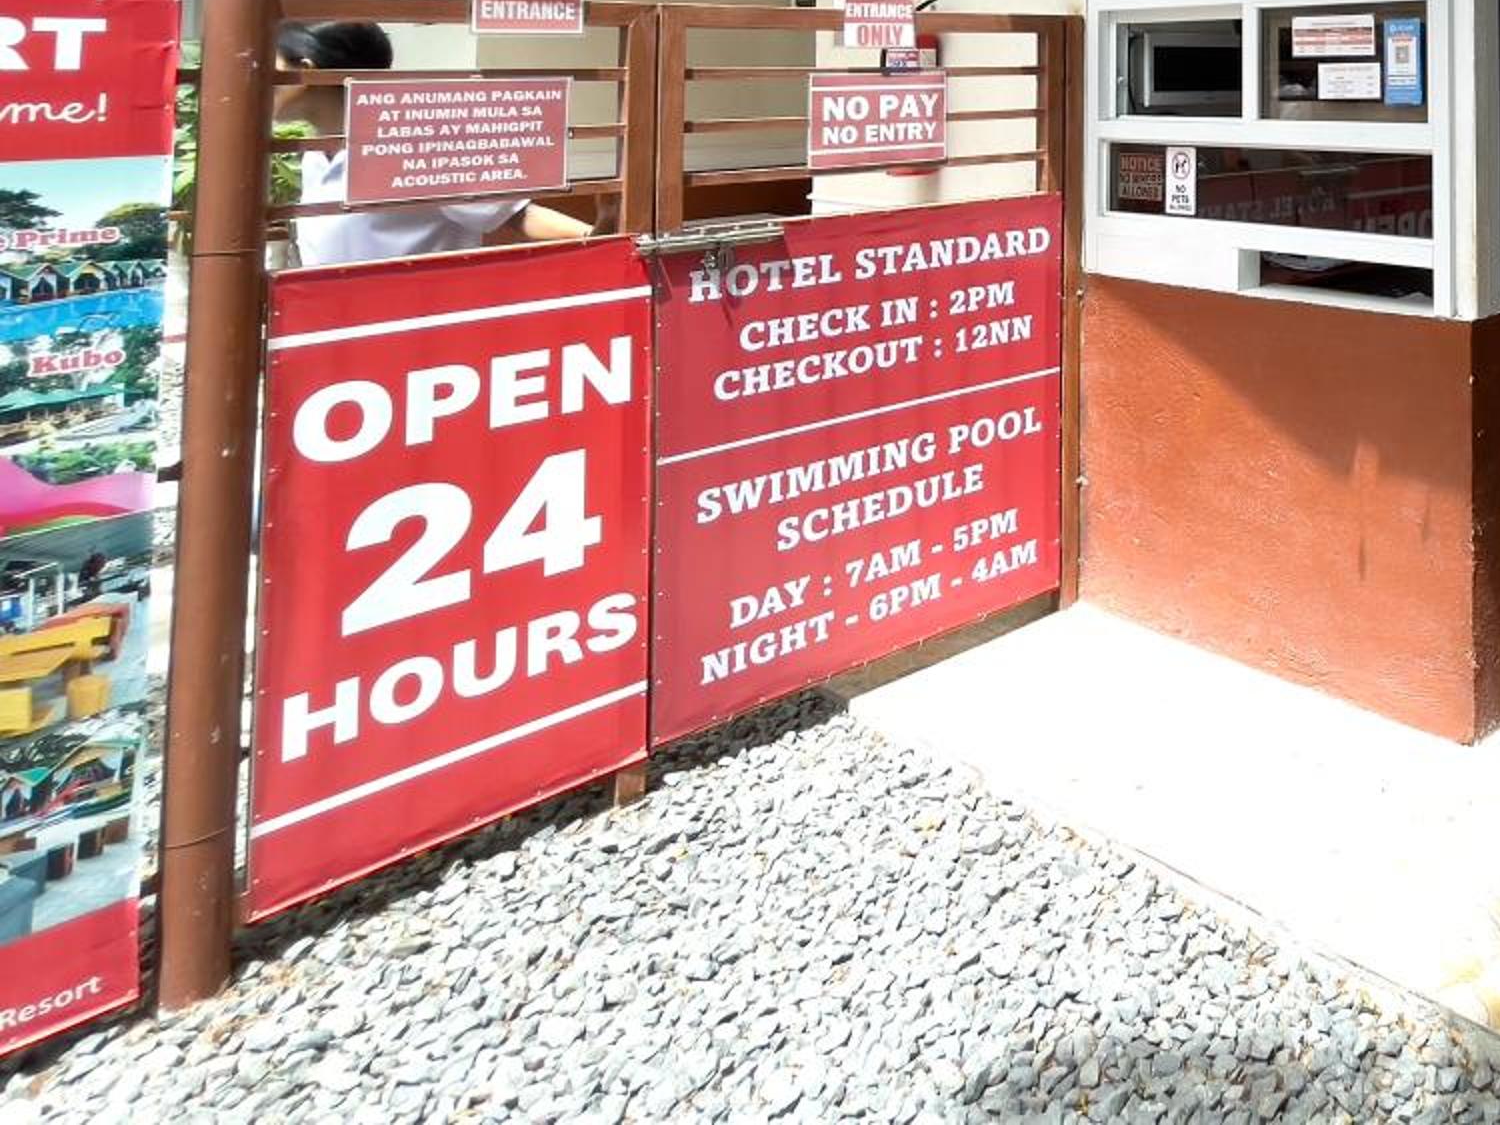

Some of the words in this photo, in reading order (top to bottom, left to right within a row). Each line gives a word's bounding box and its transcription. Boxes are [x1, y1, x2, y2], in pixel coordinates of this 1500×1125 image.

[481, 0, 576, 21] ENTRANCE
[846, 2, 913, 19] ENTRANCE
[857, 25, 903, 46] ONLY
[356, 92, 396, 106] ANG
[401, 90, 487, 104] ANUMANG
[491, 90, 562, 103] PAGKAIN
[823, 95, 870, 122] NO
[879, 93, 938, 120] PAY
[378, 110, 401, 122] AT
[406, 108, 470, 121] INUMIN
[472, 106, 517, 118] MULA
[520, 105, 543, 116] SA
[377, 126, 434, 138] LABAS
[439, 125, 462, 136] AY
[465, 120, 544, 135] MAHIGPIT
[822, 125, 858, 146] NO
[865, 121, 937, 144] ENTRY
[361, 143, 413, 156] PONG
[419, 136, 555, 153] IPINAGBABAWAL
[402, 158, 427, 171] NA
[432, 155, 495, 169] IPASOK
[498, 153, 519, 164] SA
[392, 172, 477, 188] ACOUSTIC
[480, 168, 528, 182] AREA.
[1176, 184, 1186, 193] NO
[15, 227, 119, 249] Prime
[688, 254, 841, 304] HOTEL
[855, 226, 1051, 281] STANDARD
[740, 304, 870, 352] CHECK
[880, 296, 919, 327] IN
[929, 298, 938, 318] :
[949, 281, 1016, 315] 2PM
[32, 349, 125, 374] Kubo
[713, 336, 924, 401] CHECKOUT
[933, 338, 943, 358] :
[954, 315, 1034, 353] 12NN
[292, 334, 633, 463] OPEN
[696, 432, 936, 525] SWIMMING
[949, 407, 1042, 455] POOL
[777, 463, 985, 552] SCHEDULE
[341, 448, 602, 637] 24
[729, 574, 812, 630] DAY
[823, 574, 833, 596] :
[845, 538, 922, 588] 7AM
[952, 508, 1019, 552] 5PM
[700, 610, 835, 686] NIGHT
[868, 573, 942, 623] 6PM
[970, 540, 1039, 584] 4AM
[281, 592, 637, 763] HOURS
[0, 976, 102, 1032] Resort
